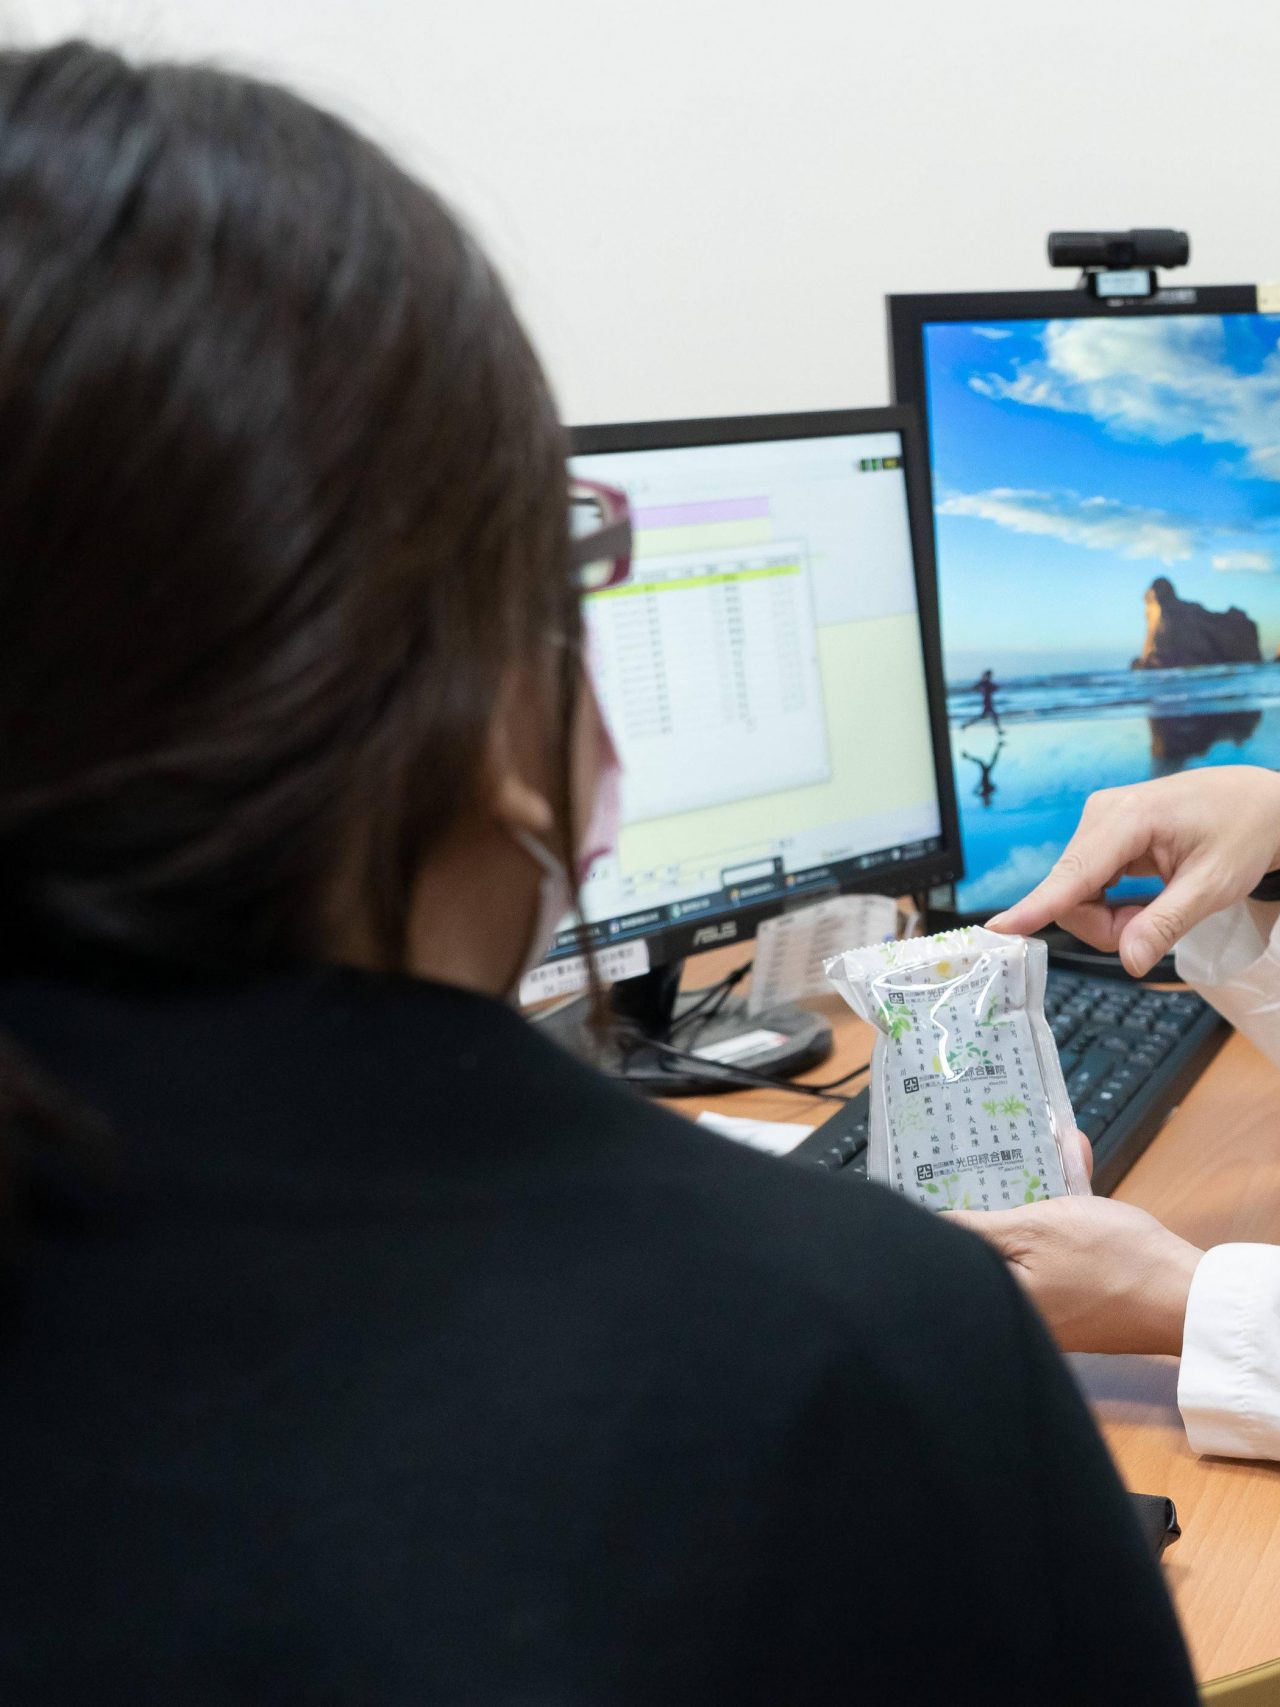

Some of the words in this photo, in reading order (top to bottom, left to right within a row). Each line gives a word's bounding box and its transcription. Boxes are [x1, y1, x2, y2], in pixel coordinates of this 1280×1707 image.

[944, 1064, 1007, 1082] 田綜合醫院
[955, 1148, 1024, 1168] 光田綜合醫院
